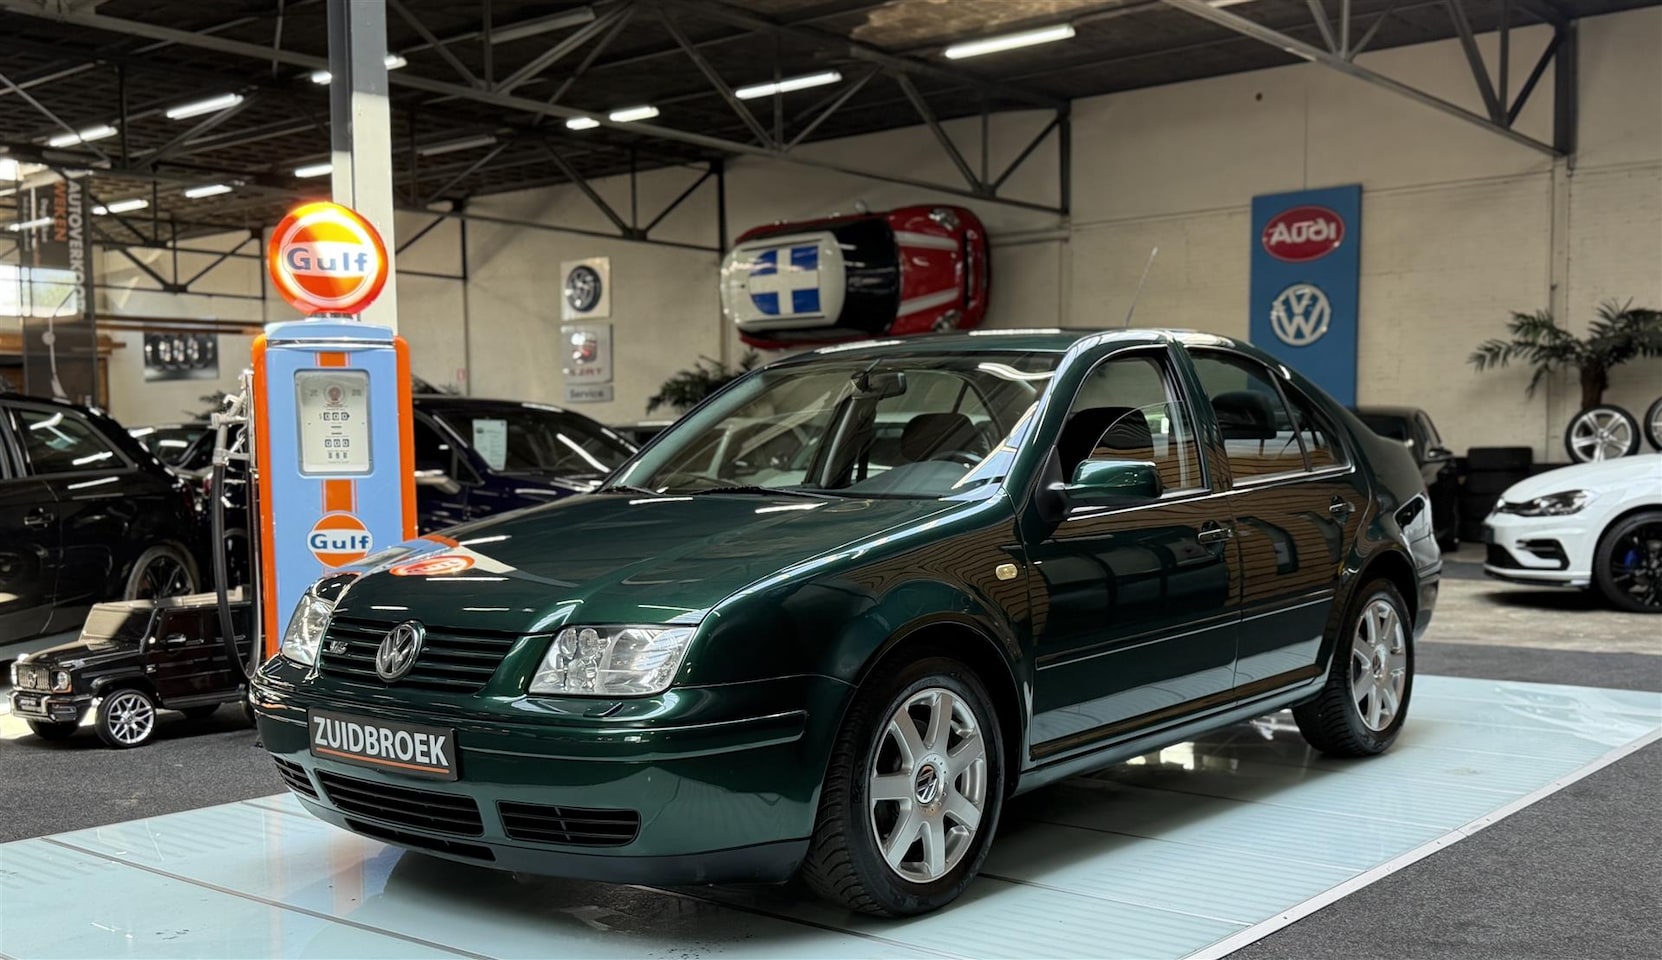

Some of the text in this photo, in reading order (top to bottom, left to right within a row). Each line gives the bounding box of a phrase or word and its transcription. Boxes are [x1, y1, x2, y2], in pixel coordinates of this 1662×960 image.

[287, 246, 368, 272] Gulf
[569, 389, 605, 398] Service
[310, 533, 369, 549] Gulf
[312, 716, 449, 766] ZUIDBROEK
